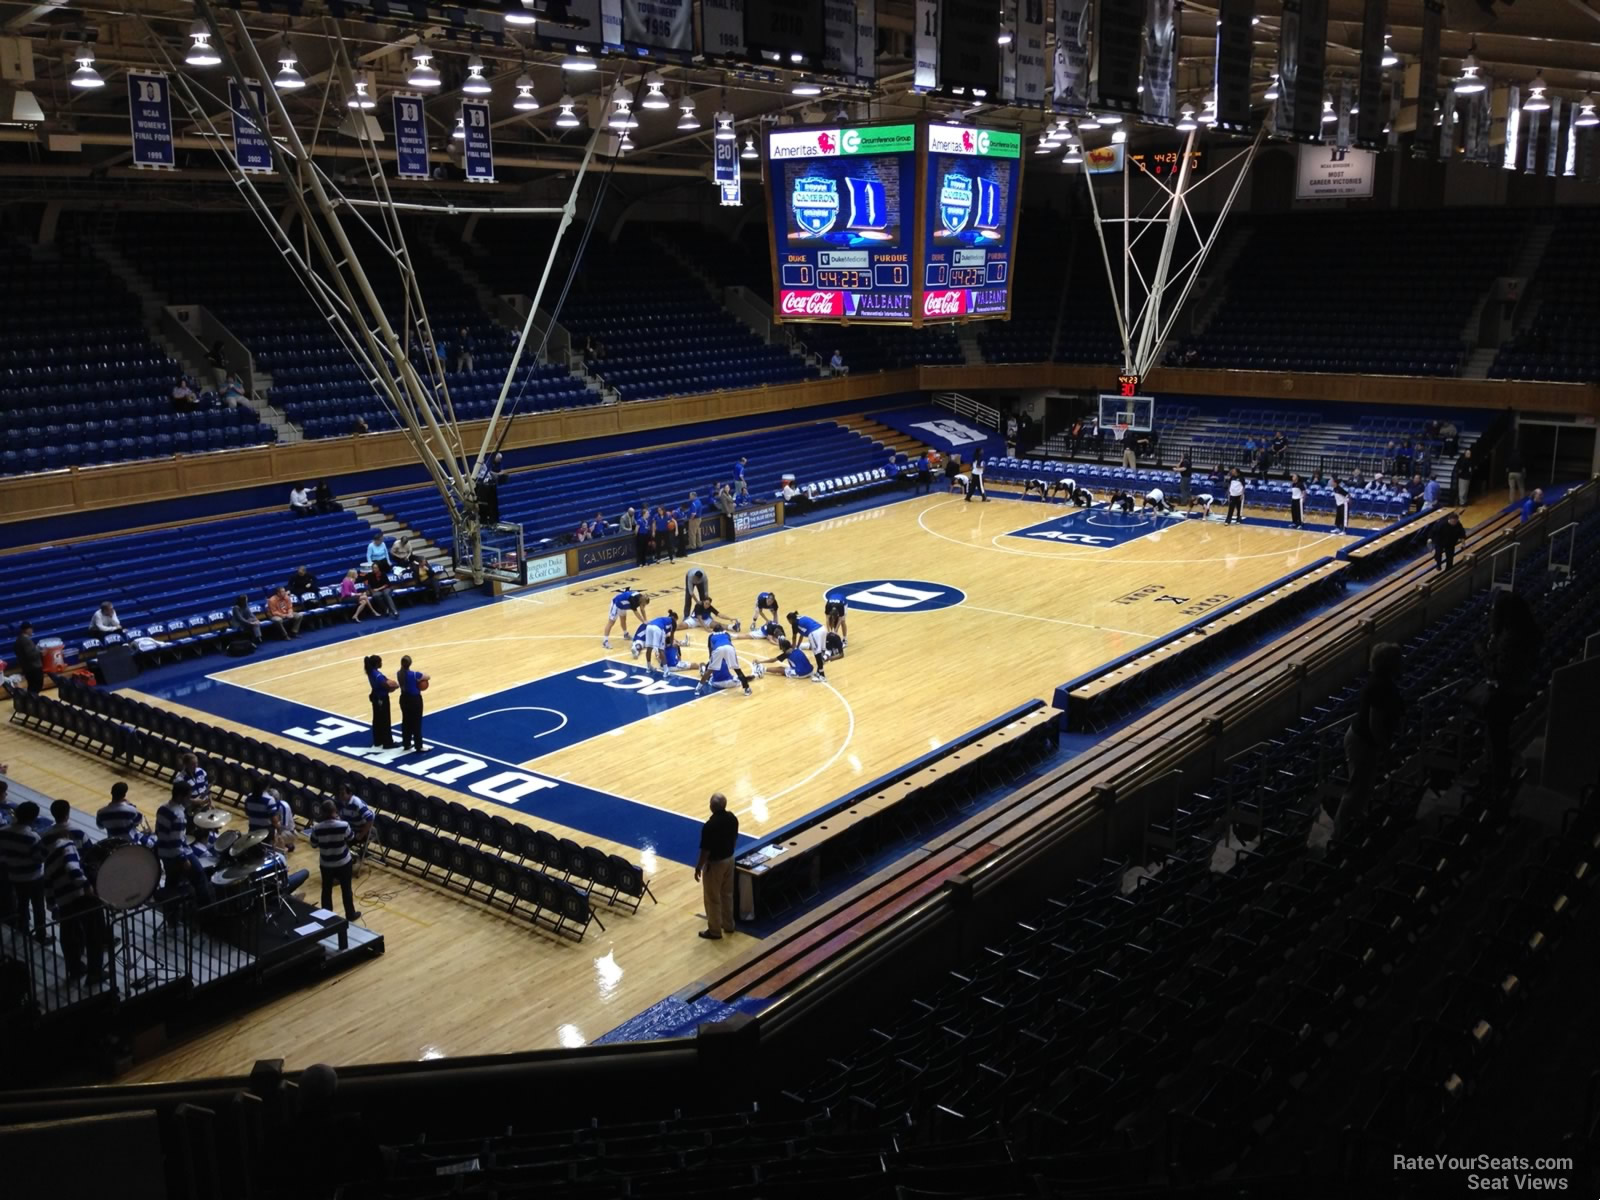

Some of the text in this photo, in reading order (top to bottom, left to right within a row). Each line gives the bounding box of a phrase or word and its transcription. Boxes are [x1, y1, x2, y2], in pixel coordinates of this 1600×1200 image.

[138, 120, 166, 130] WOMEN'S
[135, 132, 152, 140] FINAL
[861, 136, 895, 144] Circumference
[774, 145, 817, 156] Ameritas
[932, 138, 962, 152] Ameritas
[796, 194, 836, 203] CAMERON
[874, 254, 908, 262] PURDUE
[800, 267, 808, 282] 0
[894, 267, 902, 284] 0
[939, 266, 944, 282] 0
[997, 264, 1003, 280] 0
[820, 272, 858, 288] 44:23
[860, 294, 912, 308] VALEANT
[976, 290, 1006, 304] VALEANT
[1121, 384, 1134, 396] 30
[1026, 530, 1114, 544] ACC
[549, 558, 562, 566] Duke
[529, 566, 560, 580] & Golf Club
[569, 578, 641, 596] COACH
[302, 592, 316, 600] DUKE
[1115, 584, 1166, 605] COURT
[1154, 594, 1190, 604] K
[1179, 594, 1229, 616] COACH
[189, 617, 204, 626] DUKE
[209, 612, 224, 621] DUKE
[148, 625, 164, 634] DUKE
[168, 621, 184, 630] DUKE
[83, 638, 100, 649] DUKE
[576, 668, 696, 696] ACC
[282, 716, 560, 804] DUKE
